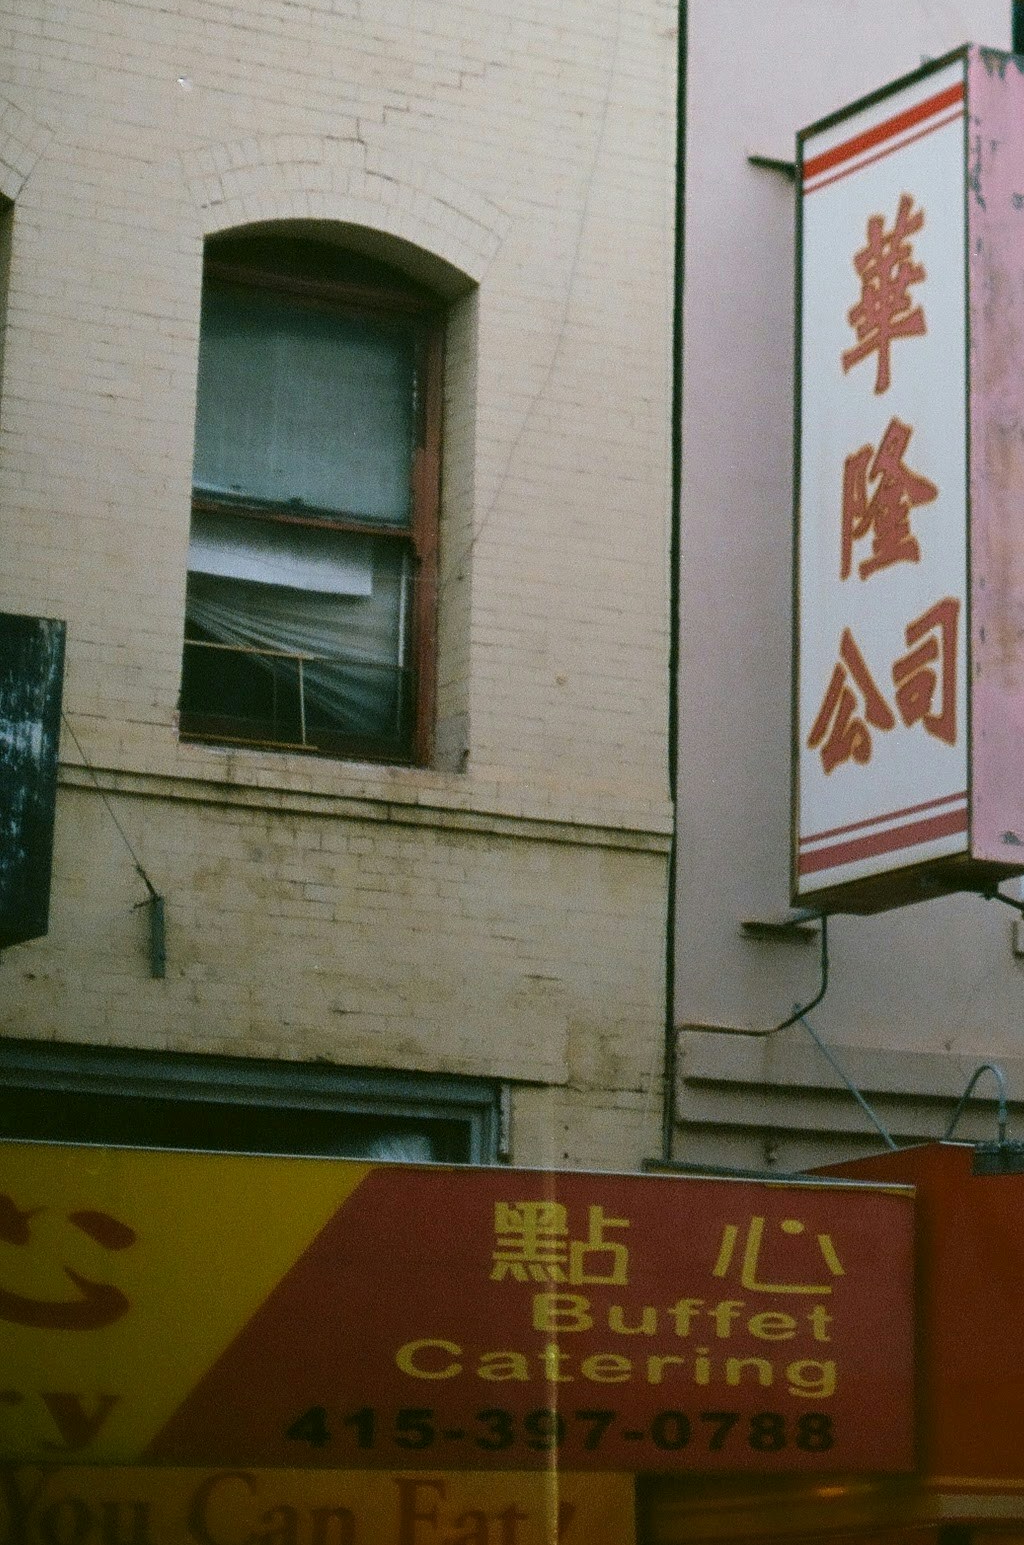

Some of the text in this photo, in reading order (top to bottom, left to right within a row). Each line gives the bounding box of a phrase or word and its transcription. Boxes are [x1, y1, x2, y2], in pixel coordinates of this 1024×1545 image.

[806, 194, 961, 776] 華隆公司
[490, 1201, 846, 1294] 點心
[532, 1293, 832, 1343] Buffet
[395, 1338, 837, 1399] Catering
[285, 1405, 835, 1453] 415-397-0788
[0, 1459, 151, 1545] You
[187, 1470, 356, 1545] Can
